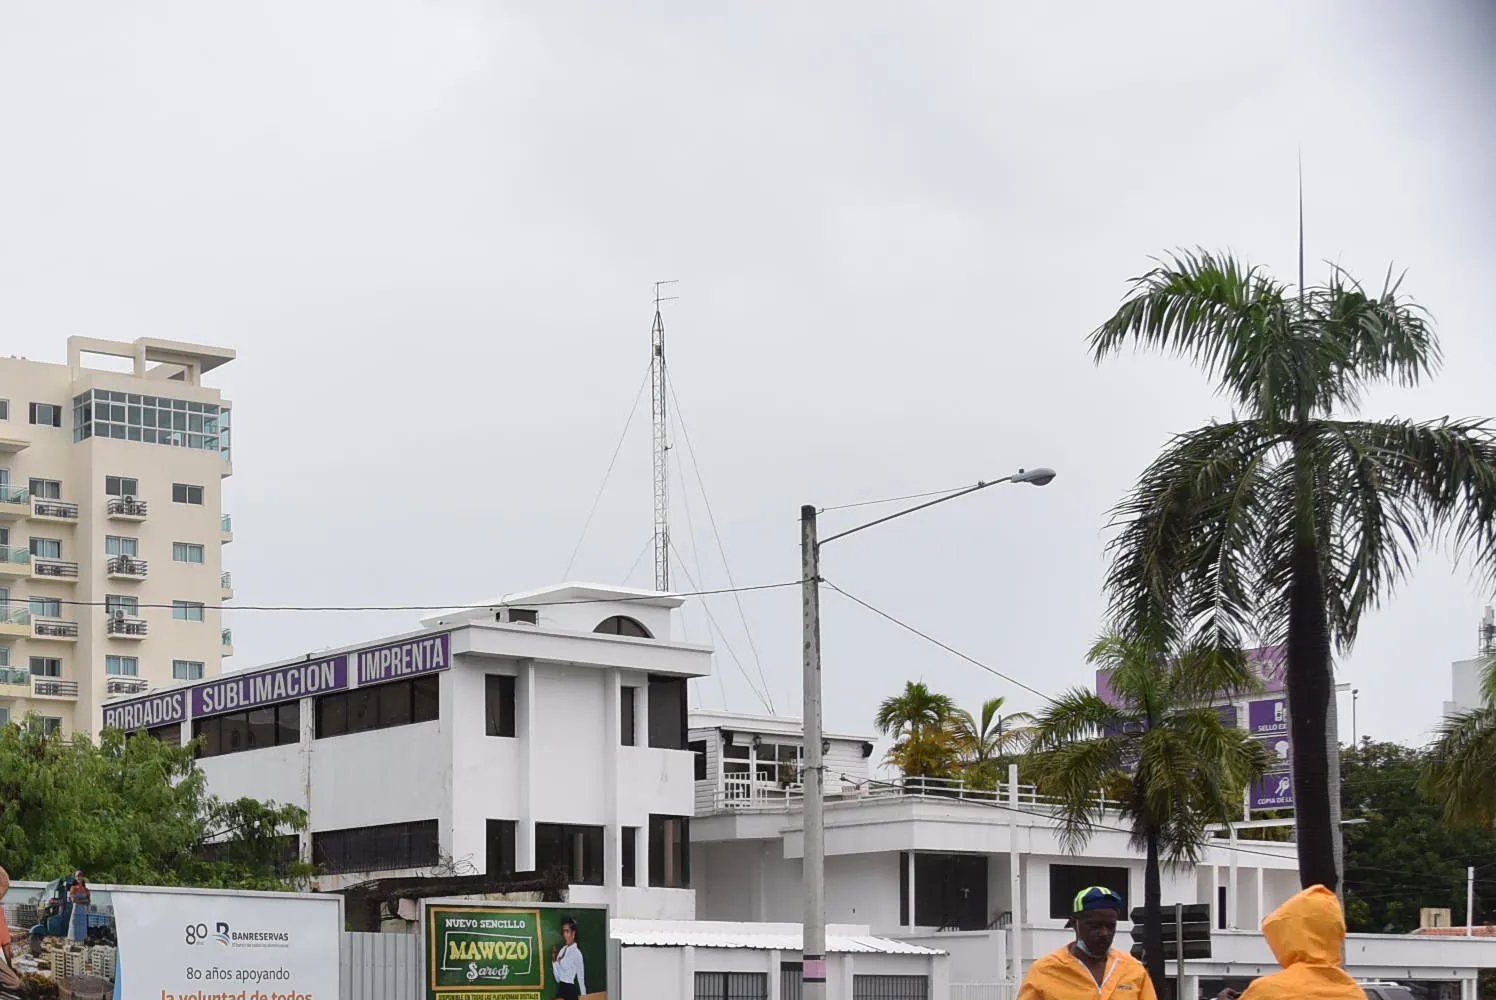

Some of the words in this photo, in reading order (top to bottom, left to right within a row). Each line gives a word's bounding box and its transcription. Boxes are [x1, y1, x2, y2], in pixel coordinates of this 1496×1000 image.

[361, 637, 444, 680] IMPRENTA
[201, 661, 336, 713] SUBLIMACION
[106, 694, 182, 728] BORDADOS
[1258, 724, 1278, 732] SELLO
[446, 918, 478, 928] NUEVO
[480, 920, 526, 929] SENCILLO
[185, 923, 208, 945] 80
[232, 932, 289, 941] BANRESERVAS
[449, 940, 529, 960] MAWOZO
[186, 967, 202, 980] 80
[205, 967, 232, 980] años
[236, 966, 290, 984] apoyando
